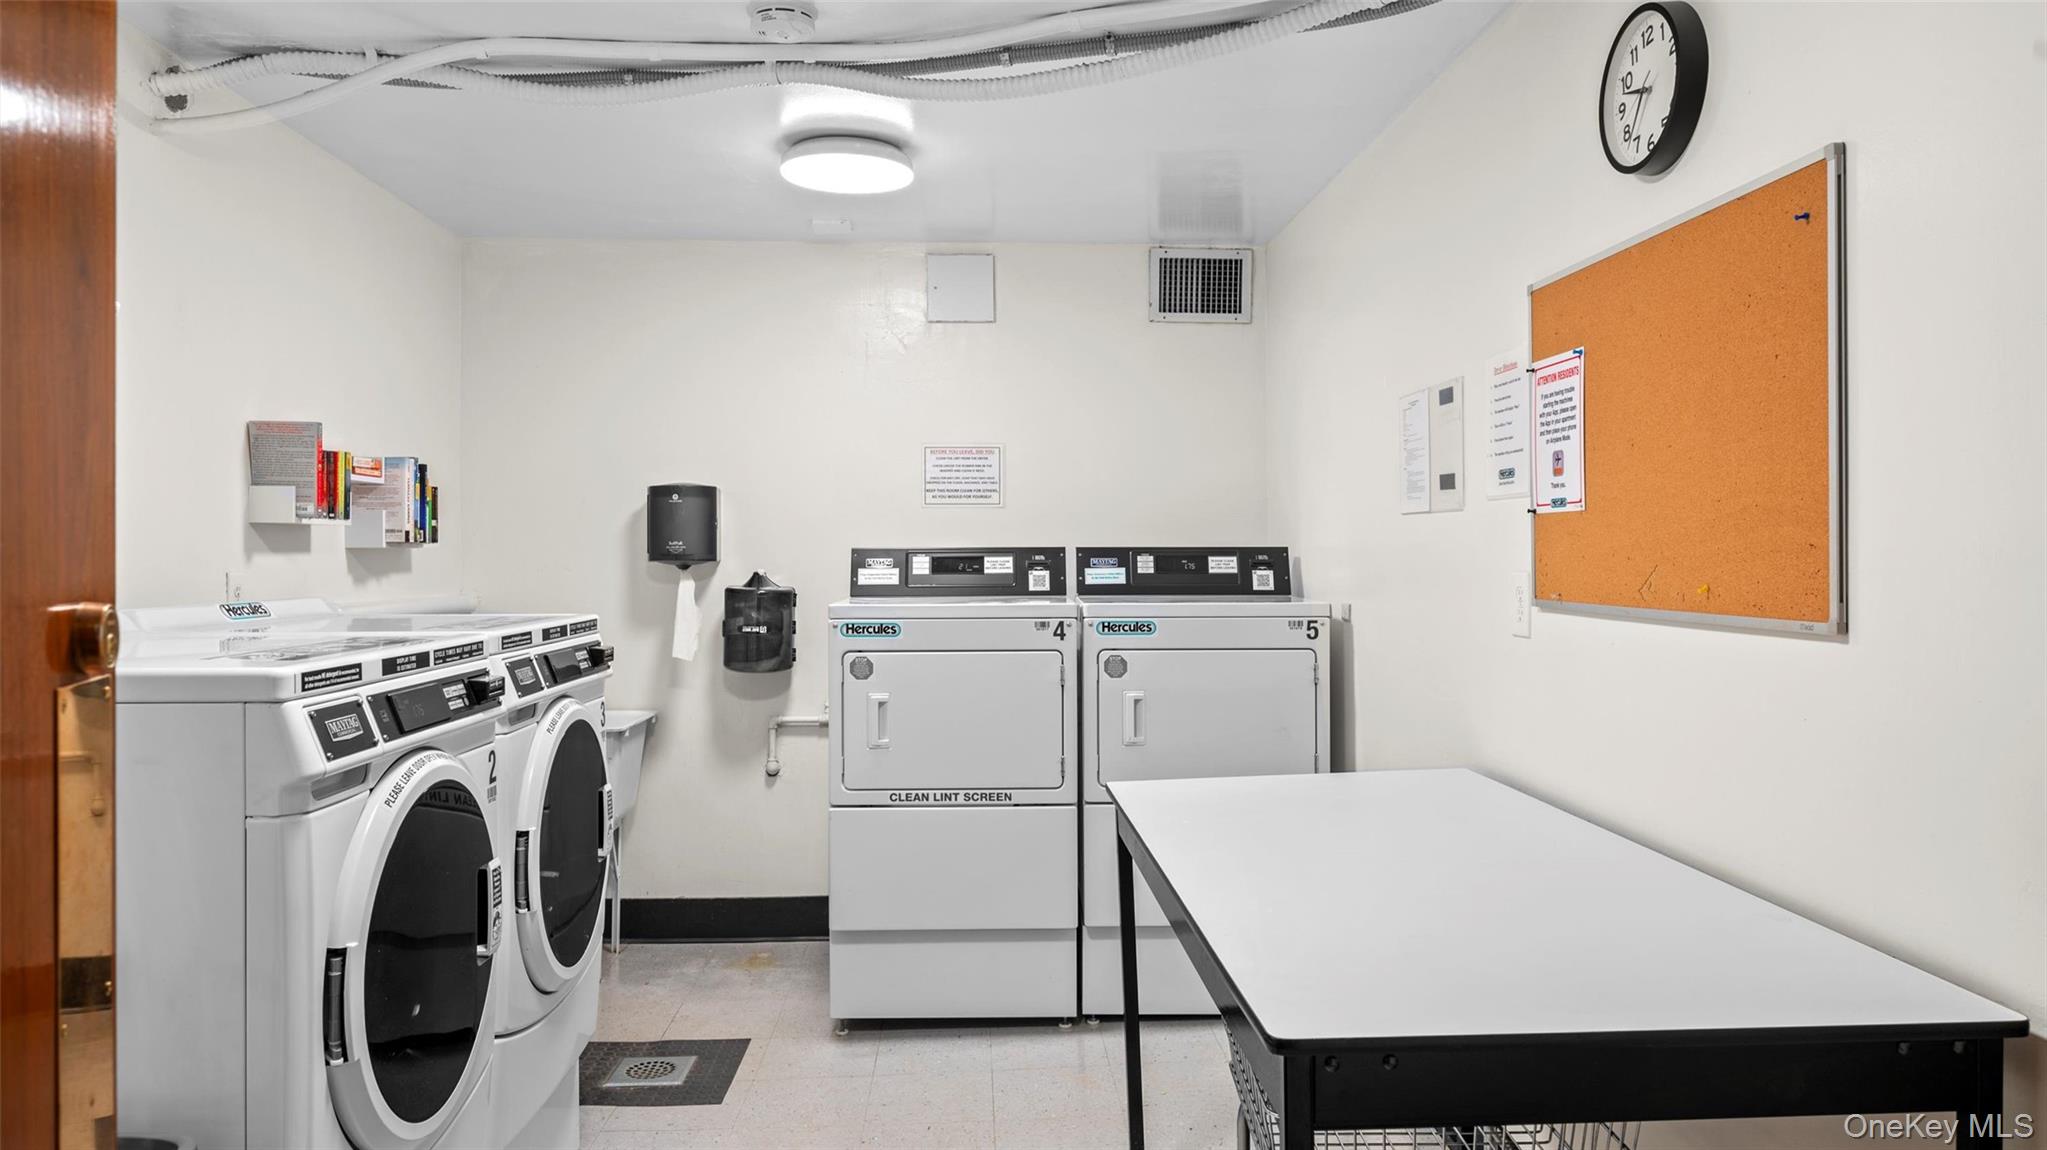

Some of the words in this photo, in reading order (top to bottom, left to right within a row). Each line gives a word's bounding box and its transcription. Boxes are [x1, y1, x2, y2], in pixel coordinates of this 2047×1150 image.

[1641, 25, 1654, 48] 12
[1630, 45, 1638, 66] 11
[1621, 71, 1633, 93] 10
[1618, 102, 1626, 120] 9
[1623, 124, 1631, 142] 8
[1633, 135, 1640, 153] 7
[1537, 373, 1556, 386] ATTENTION
[1558, 366, 1579, 381] RESIDENTS
[222, 603, 268, 616] Hercules
[846, 623, 897, 634] Hercules
[1053, 621, 1066, 640] 4
[1102, 621, 1152, 632] Hercules
[1306, 620, 1319, 640] 5
[601, 701, 606, 727] 3
[329, 717, 359, 734] MAYTAG
[546, 717, 559, 735] PLEASE
[488, 750, 496, 784] 2
[384, 780, 405, 808] PLEASE
[401, 767, 417, 785] LEAVE
[412, 757, 426, 771] DOOR
[889, 792, 929, 802] CLEAN
[933, 792, 959, 801] LINT
[964, 792, 1012, 802] SCREEN
